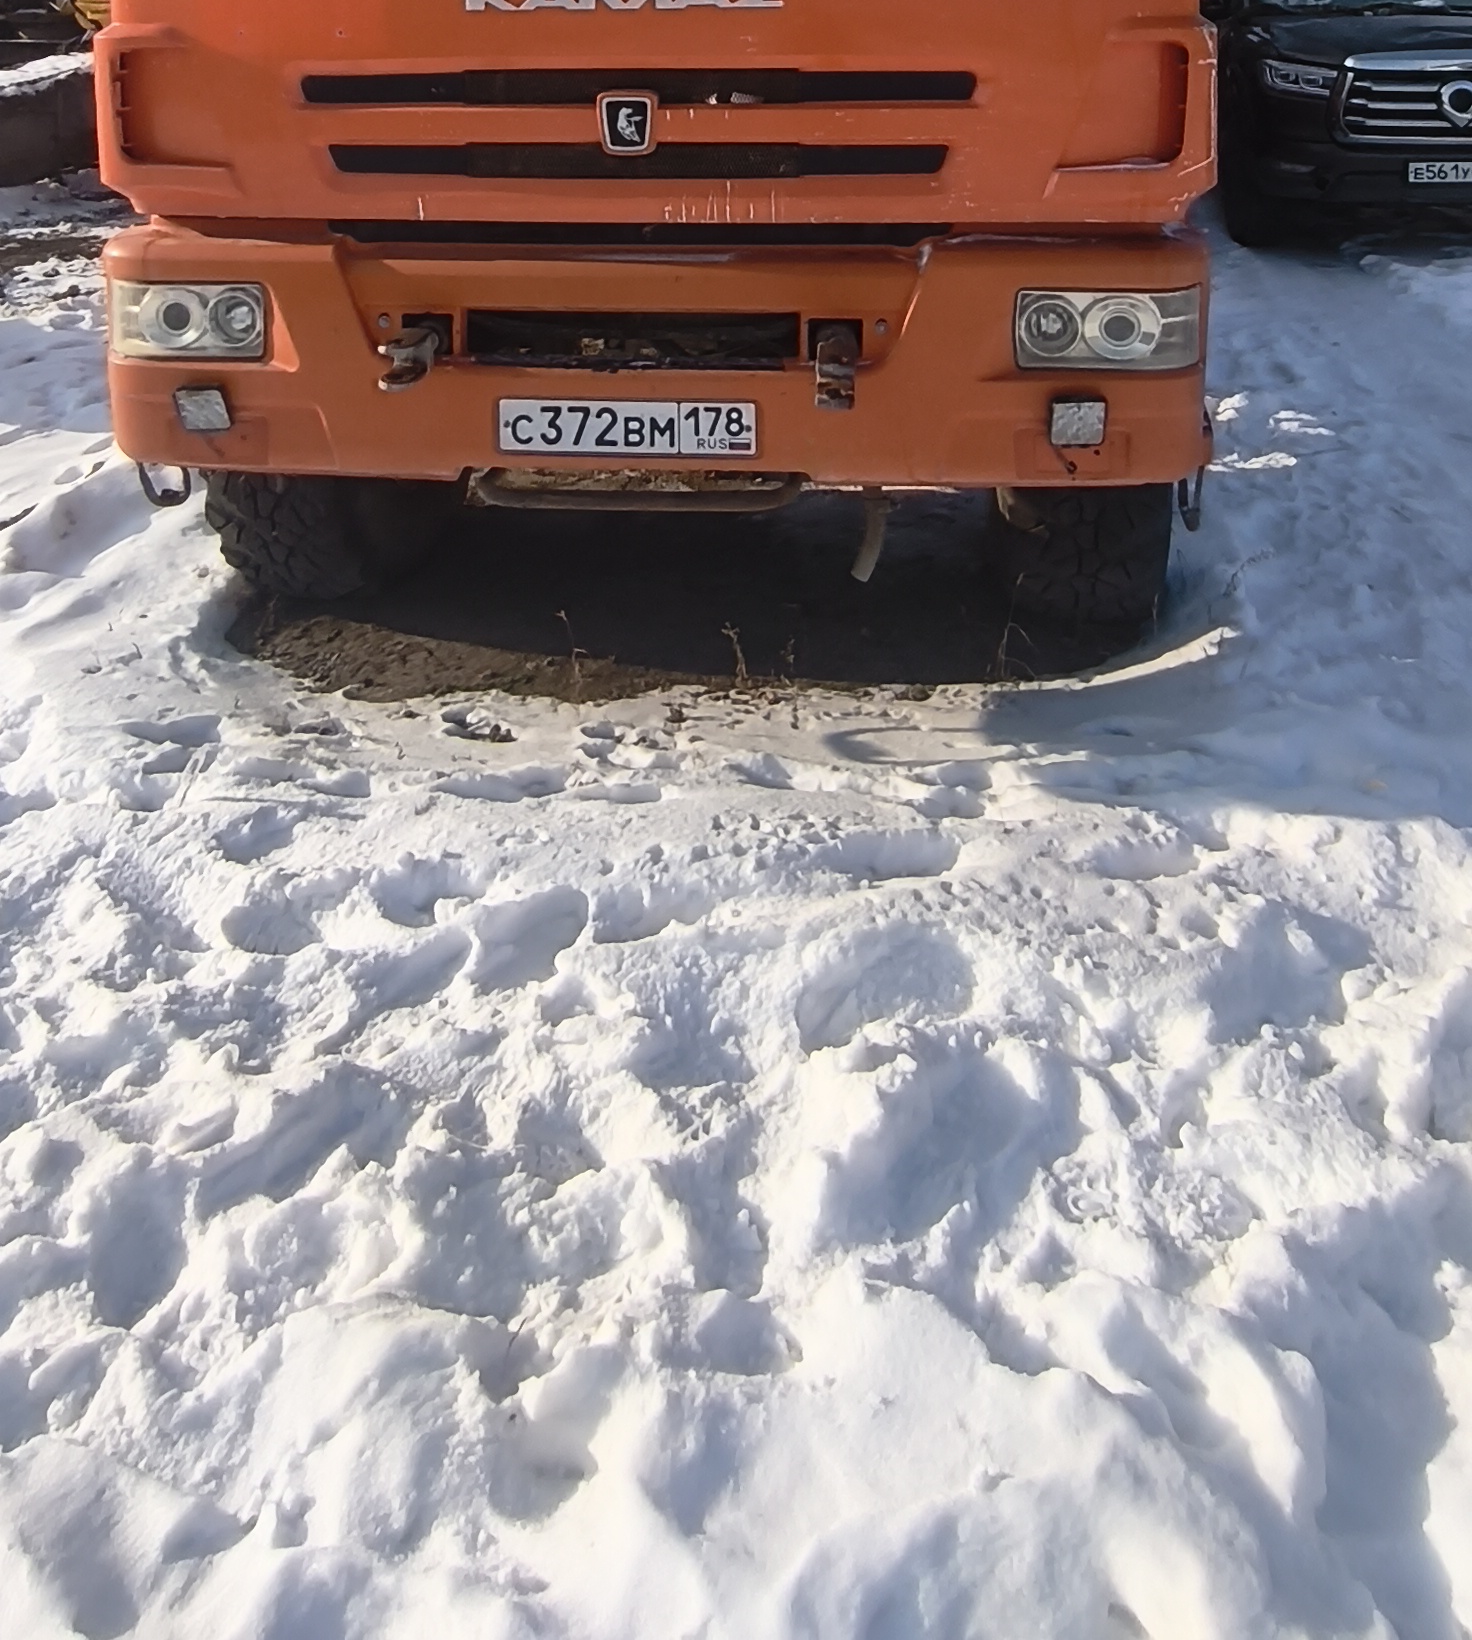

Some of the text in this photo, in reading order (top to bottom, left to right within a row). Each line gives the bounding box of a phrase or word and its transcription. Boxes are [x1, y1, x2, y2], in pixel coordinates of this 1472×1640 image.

[511, 406, 744, 448] С372ВМ 178
[696, 438, 728, 450] RUS
